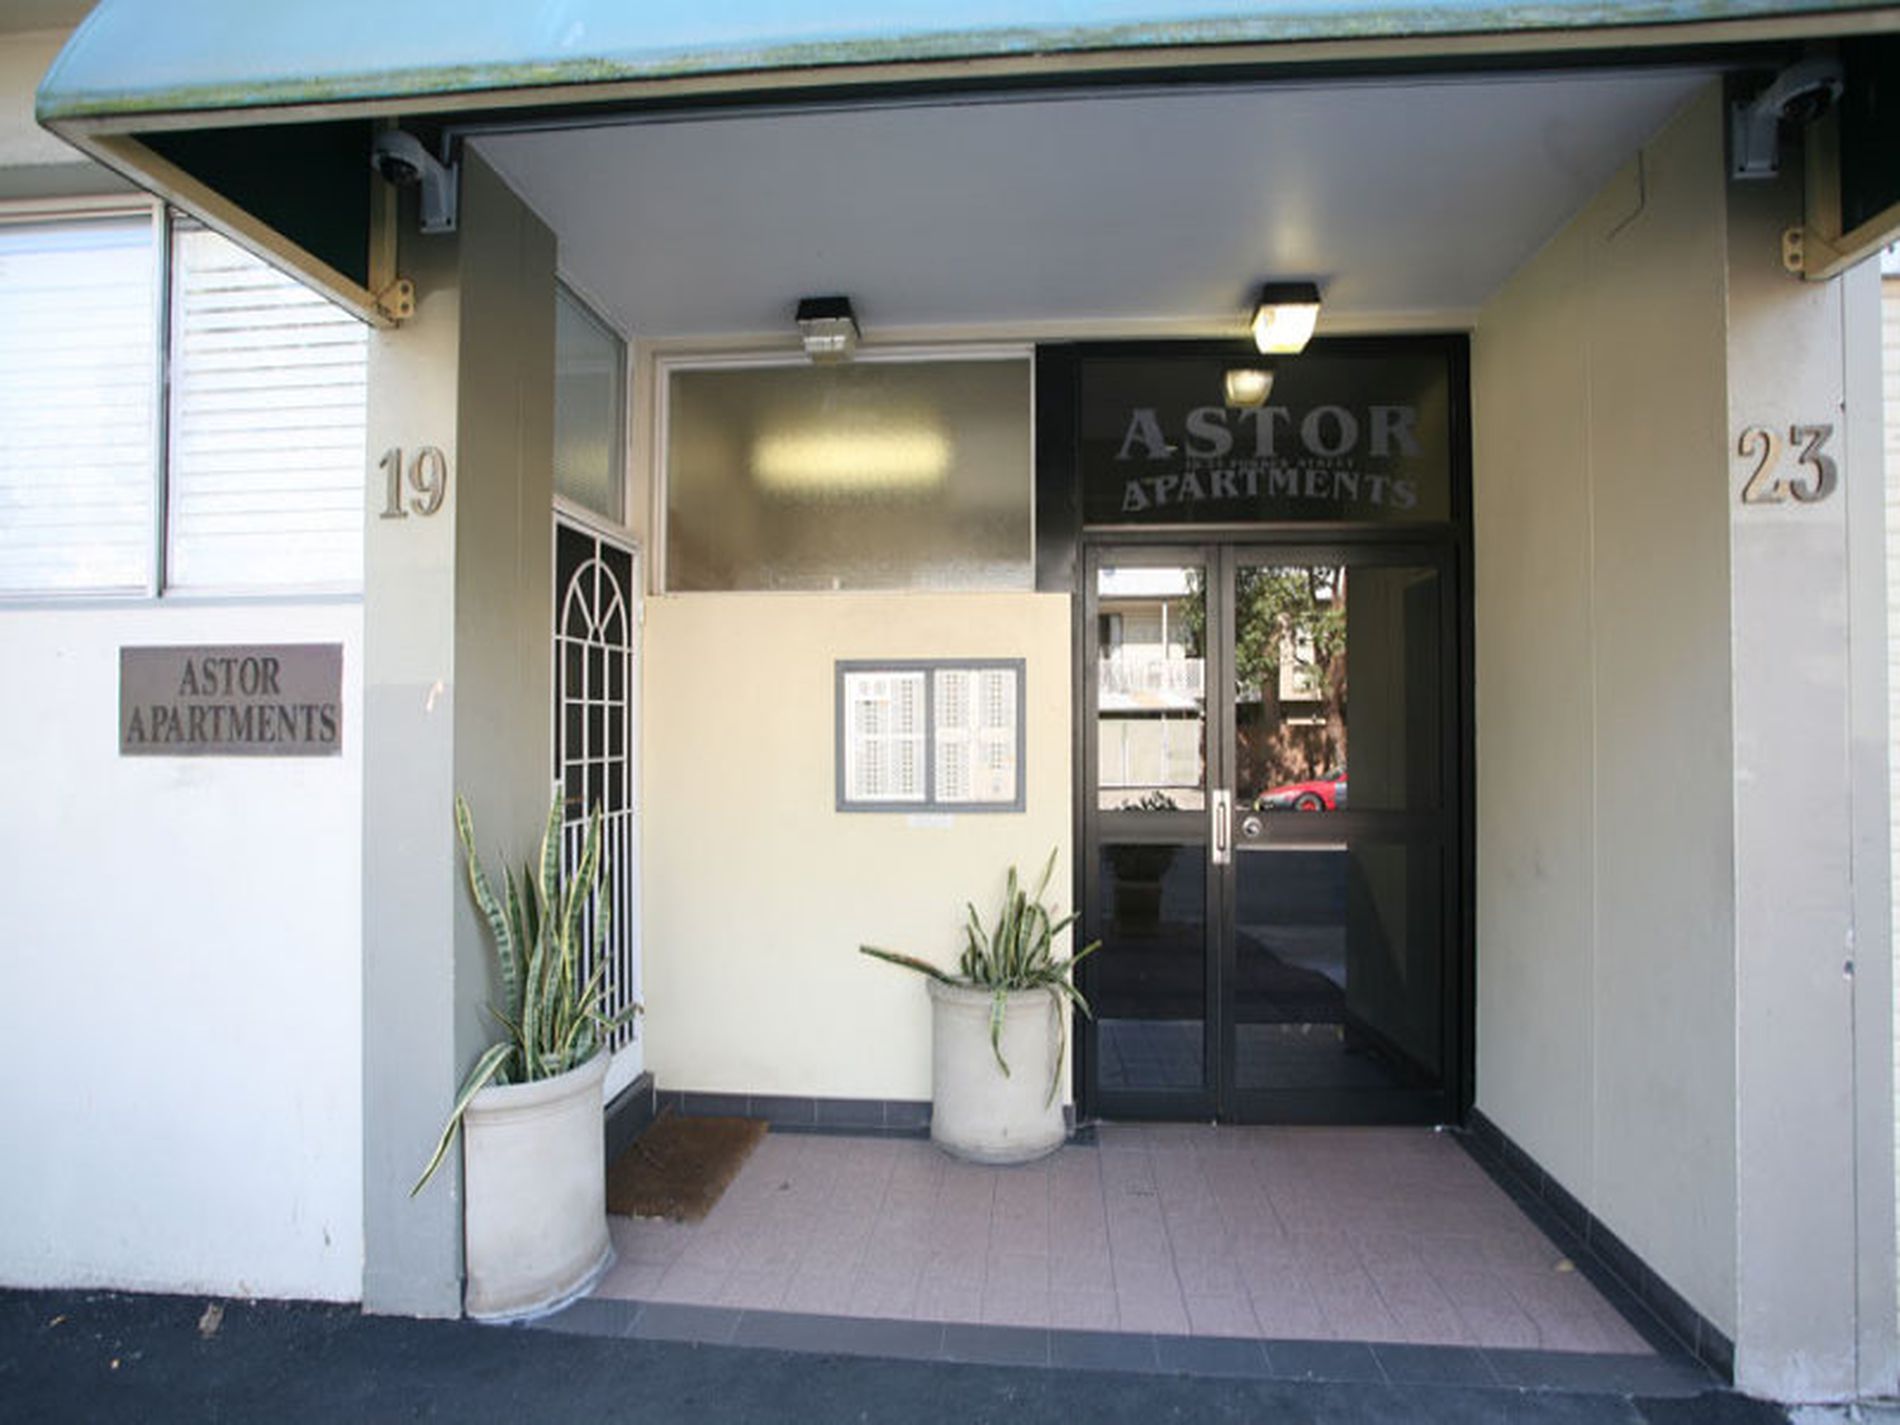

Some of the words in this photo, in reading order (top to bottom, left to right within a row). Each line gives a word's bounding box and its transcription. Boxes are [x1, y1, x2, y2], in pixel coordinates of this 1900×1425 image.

[1115, 405, 1423, 460] ASTOR
[379, 446, 447, 519] 19
[1737, 423, 1838, 505] 23
[1121, 467, 1418, 513] APARTMENTS
[178, 656, 280, 696] ASTOR
[126, 702, 337, 744] APARTMENTS
